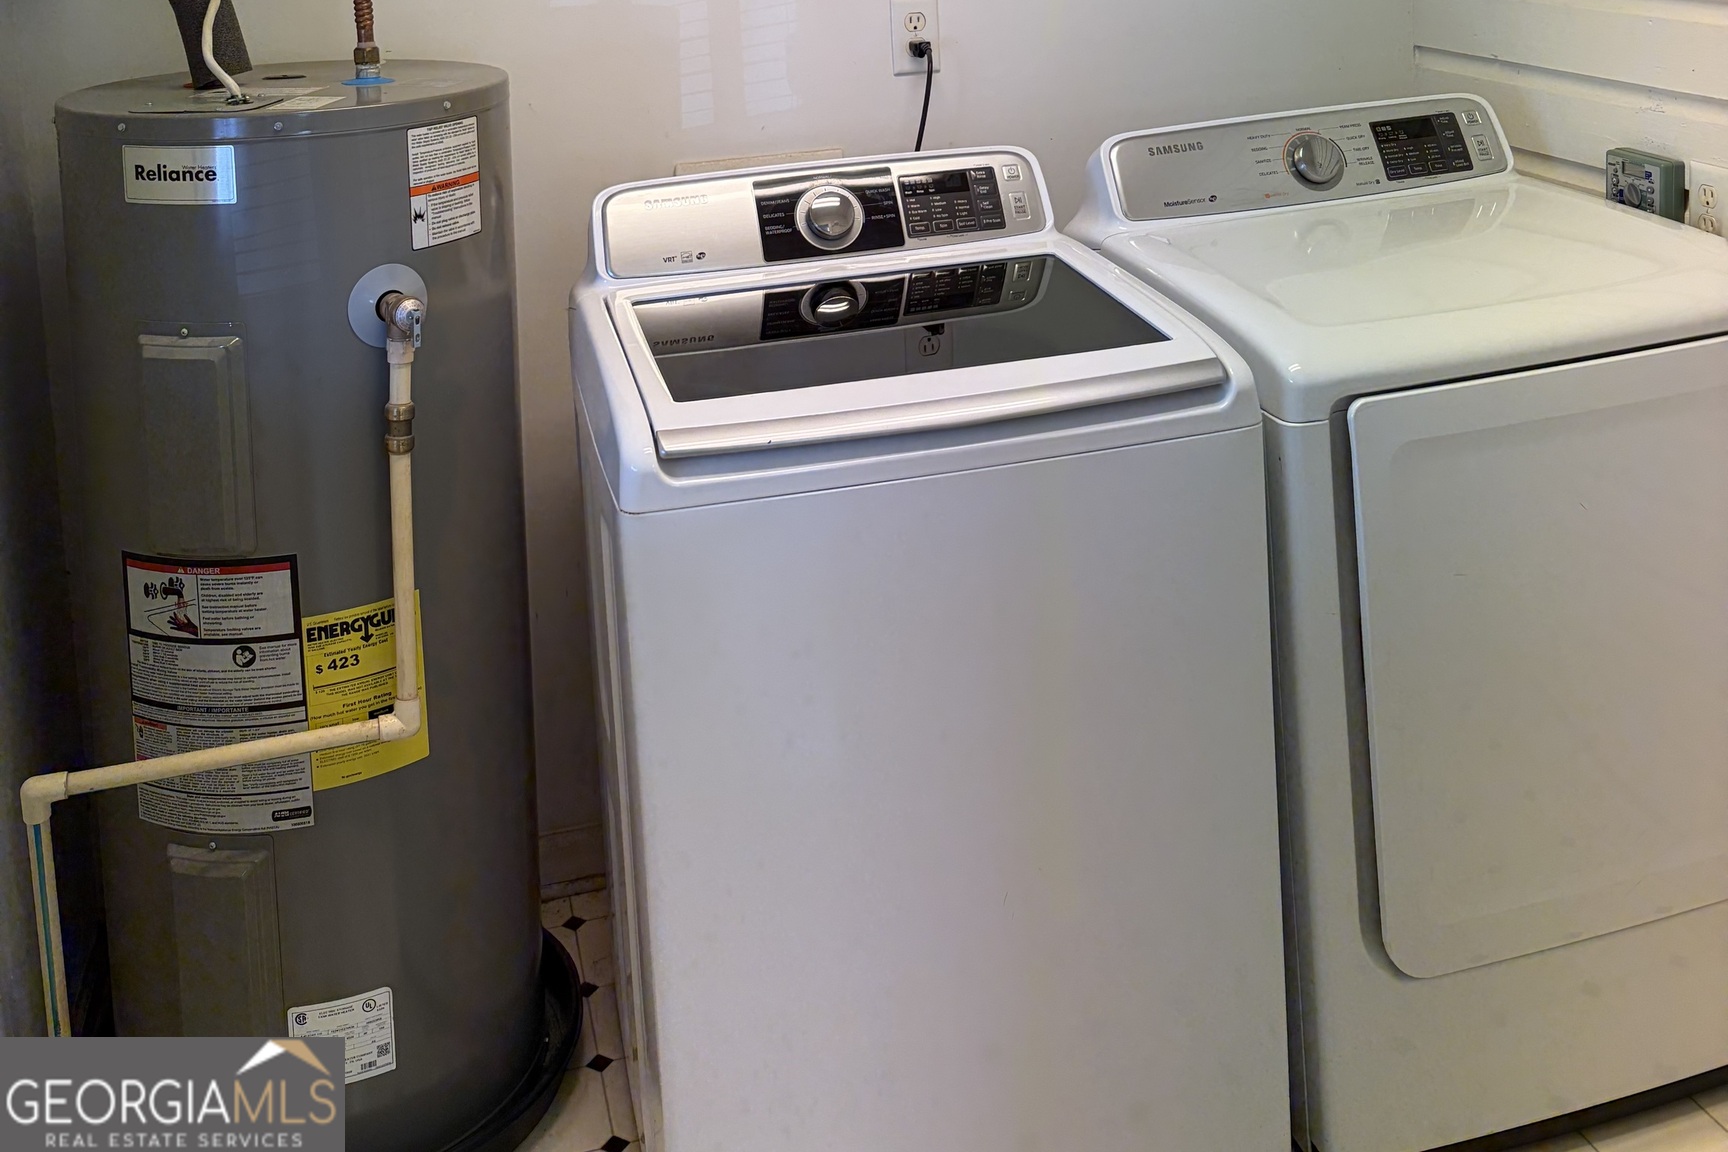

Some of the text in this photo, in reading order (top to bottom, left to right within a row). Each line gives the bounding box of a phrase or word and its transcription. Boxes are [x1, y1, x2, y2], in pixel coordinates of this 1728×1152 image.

[1148, 141, 1204, 157] SAMSUNG
[134, 164, 217, 182] Reliance
[644, 194, 708, 210] SAMSUNG
[1164, 197, 1206, 208] MoistureSensor
[187, 567, 221, 575] DANGER
[306, 608, 395, 643] ENERGYGUI
[315, 653, 360, 675] $ 423
[357, 697, 373, 705] Hour
[373, 691, 392, 700] Rating
[177, 705, 207, 713] IMPORTANT
